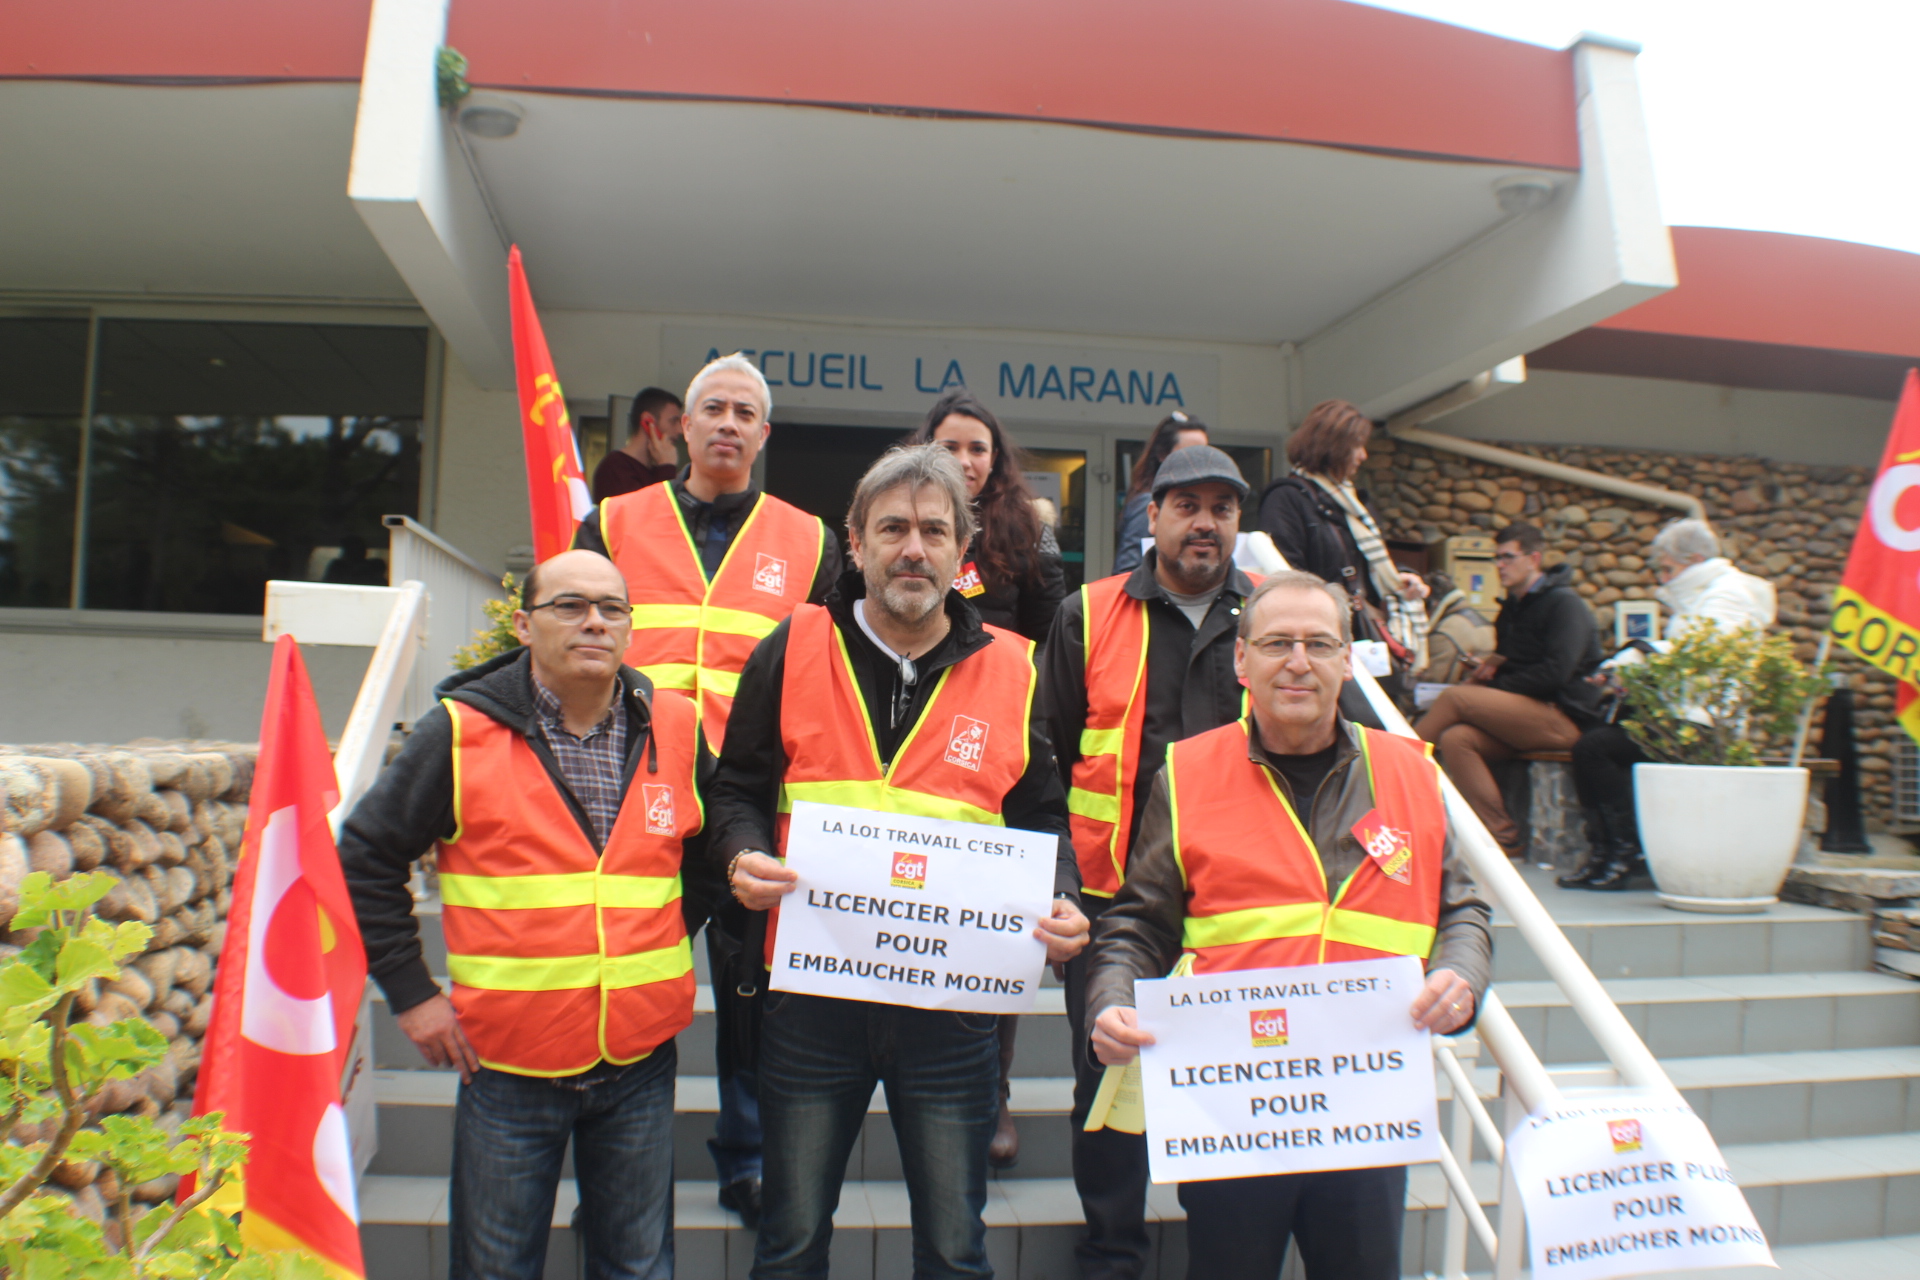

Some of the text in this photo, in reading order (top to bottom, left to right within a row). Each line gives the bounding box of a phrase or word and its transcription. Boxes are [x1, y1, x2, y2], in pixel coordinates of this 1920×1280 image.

[914, 357, 965, 394] LA
[999, 362, 1185, 408] MARANA
[756, 570, 782, 588] cgt
[951, 569, 980, 590] cgt
[961, 586, 984, 598] ORSE
[1828, 600, 1920, 686] COR
[947, 755, 976, 770] CORSICA
[949, 739, 981, 760] cgt
[648, 807, 673, 827] cgt
[822, 820, 844, 834] LA
[849, 823, 880, 839] LOI
[887, 829, 962, 850] TRAVAIL
[1367, 825, 1399, 858] cgt
[895, 861, 924, 879] cgt
[807, 889, 1025, 933] LICENCIER PLUS
[875, 932, 948, 958] POUR
[788, 952, 1026, 995] EMBAUCHER MOINS
[1169, 994, 1193, 1007] LA
[1199, 990, 1233, 1004] LOI
[1238, 983, 1322, 1001] TRAVAIL
[1254, 1016, 1285, 1037] cgt
[1169, 1057, 1324, 1088] LICENCIER
[1332, 1051, 1405, 1075] PLUS
[1250, 1093, 1331, 1117] POUR
[1164, 1120, 1423, 1157] EMBAUCHER MOINS
[1545, 1161, 1736, 1198] LICENCIER PLUS
[1613, 1194, 1686, 1221] POUR
[1544, 1225, 1766, 1268] EMBAUCHER MOINS
